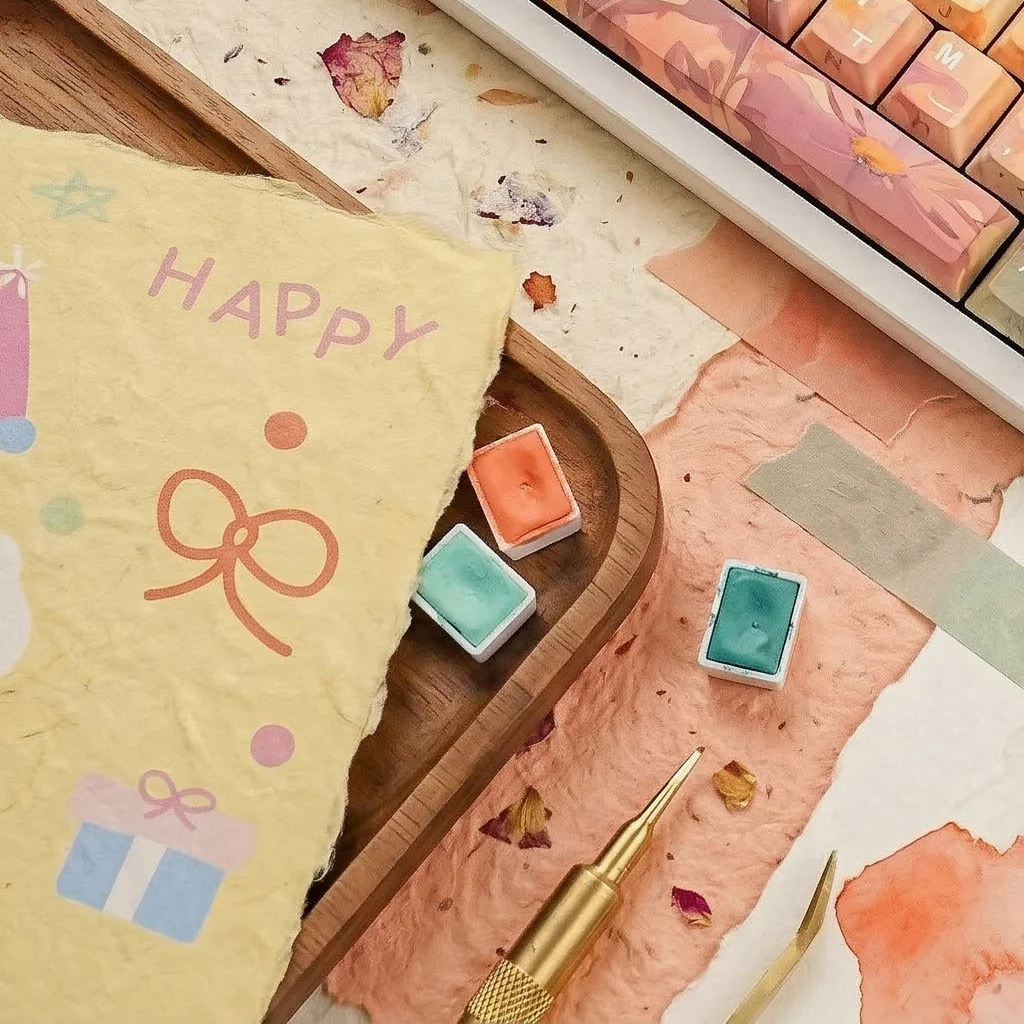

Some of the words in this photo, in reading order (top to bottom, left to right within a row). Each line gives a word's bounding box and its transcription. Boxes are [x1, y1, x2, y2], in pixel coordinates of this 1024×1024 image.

[938, 5, 952, 18] J
[934, 42, 965, 71] M
[148, 246, 440, 362] HAPPY
